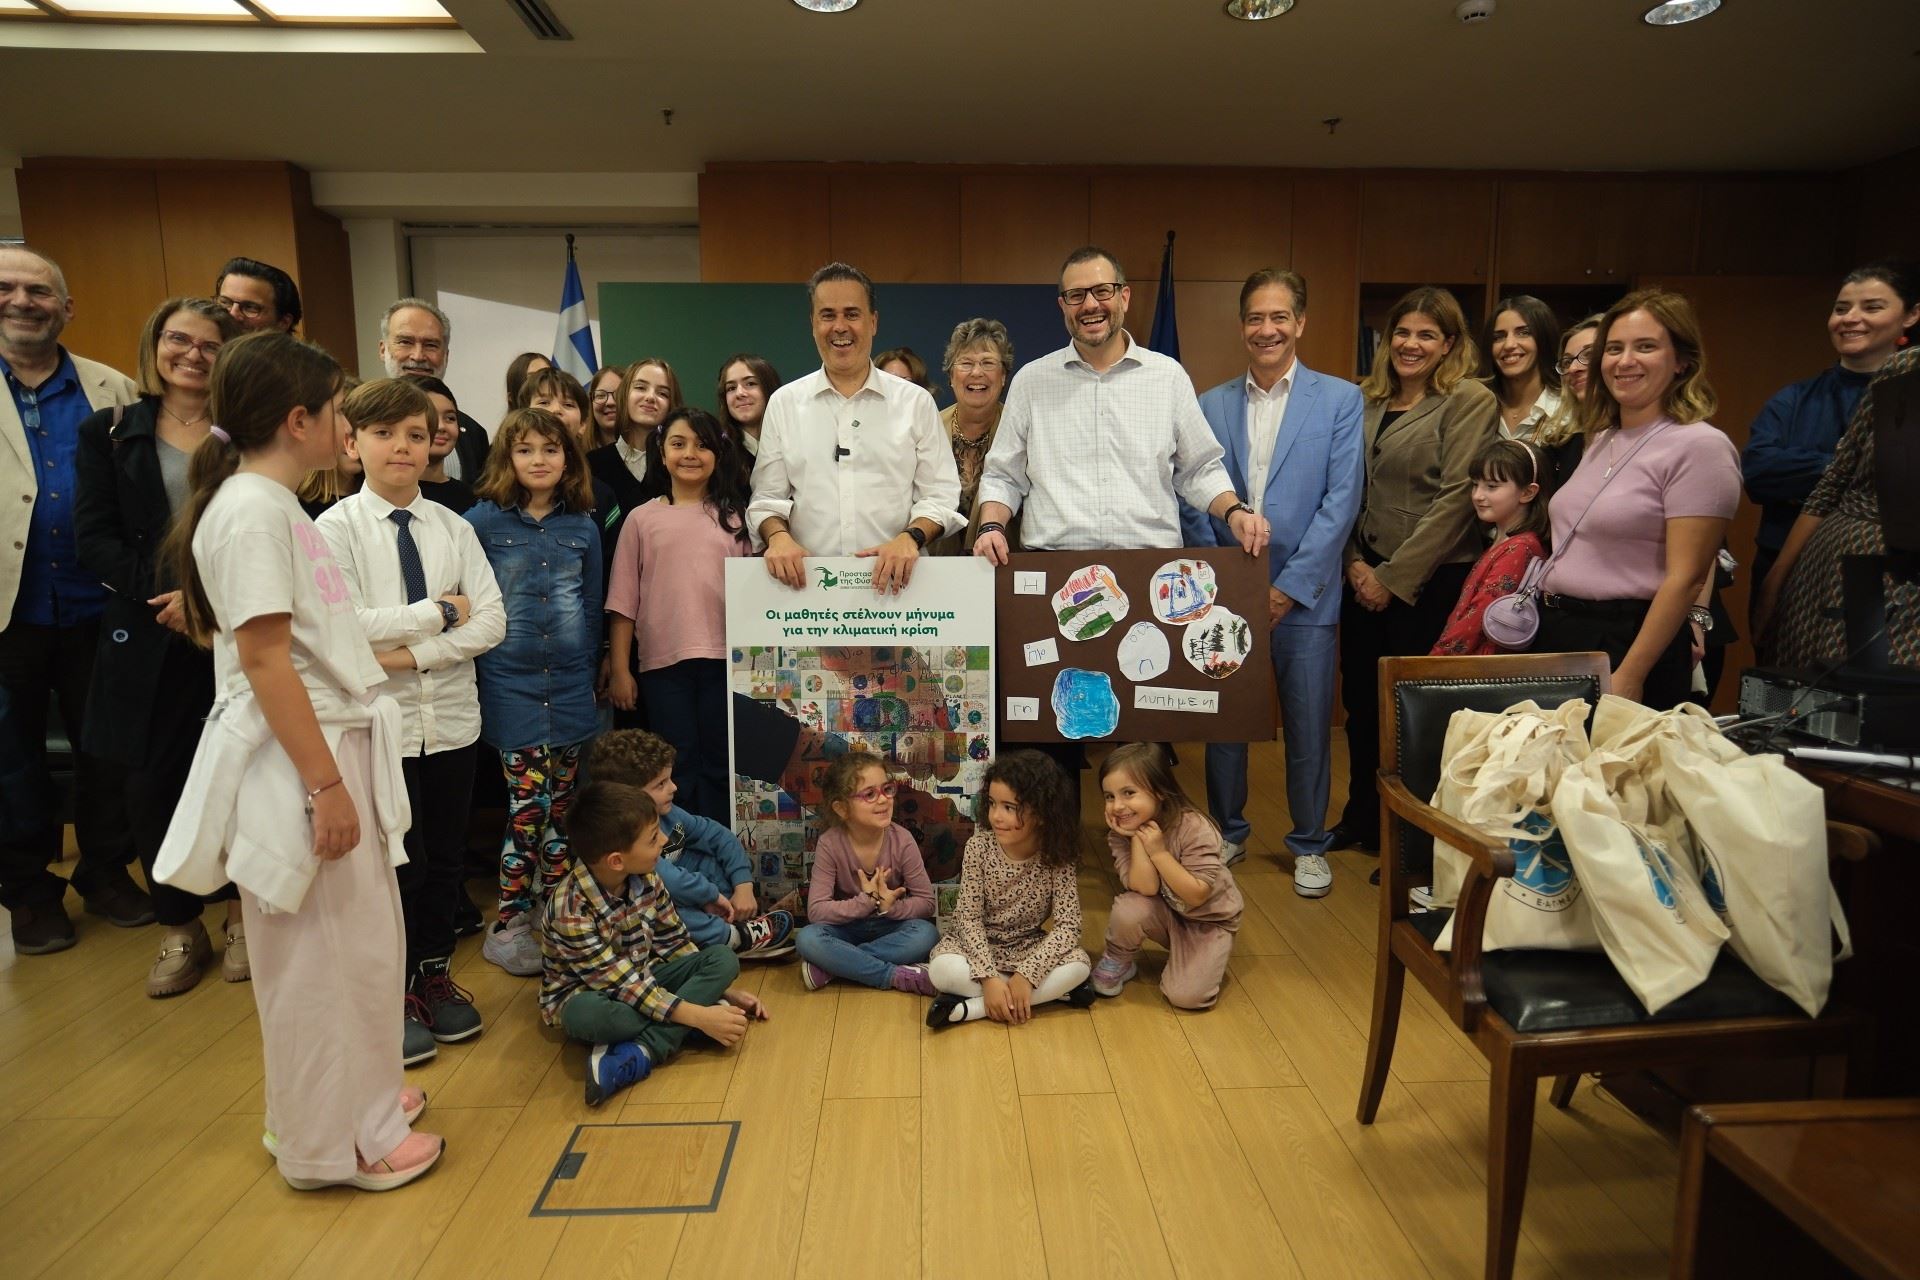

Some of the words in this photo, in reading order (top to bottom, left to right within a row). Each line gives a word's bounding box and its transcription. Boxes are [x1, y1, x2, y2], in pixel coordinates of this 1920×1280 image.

[839, 570, 872, 578] Προστασ
[840, 578, 853, 586] της
[854, 577, 873, 585] Φύσ
[765, 609, 781, 620] Οι
[784, 608, 839, 622] μαθητές
[842, 608, 902, 620] στέλνουν
[906, 608, 955, 622] μήνυμα
[783, 627, 804, 637] για
[806, 627, 829, 637] την
[833, 623, 897, 637] κλιματική
[901, 623, 938, 637] κρίση
